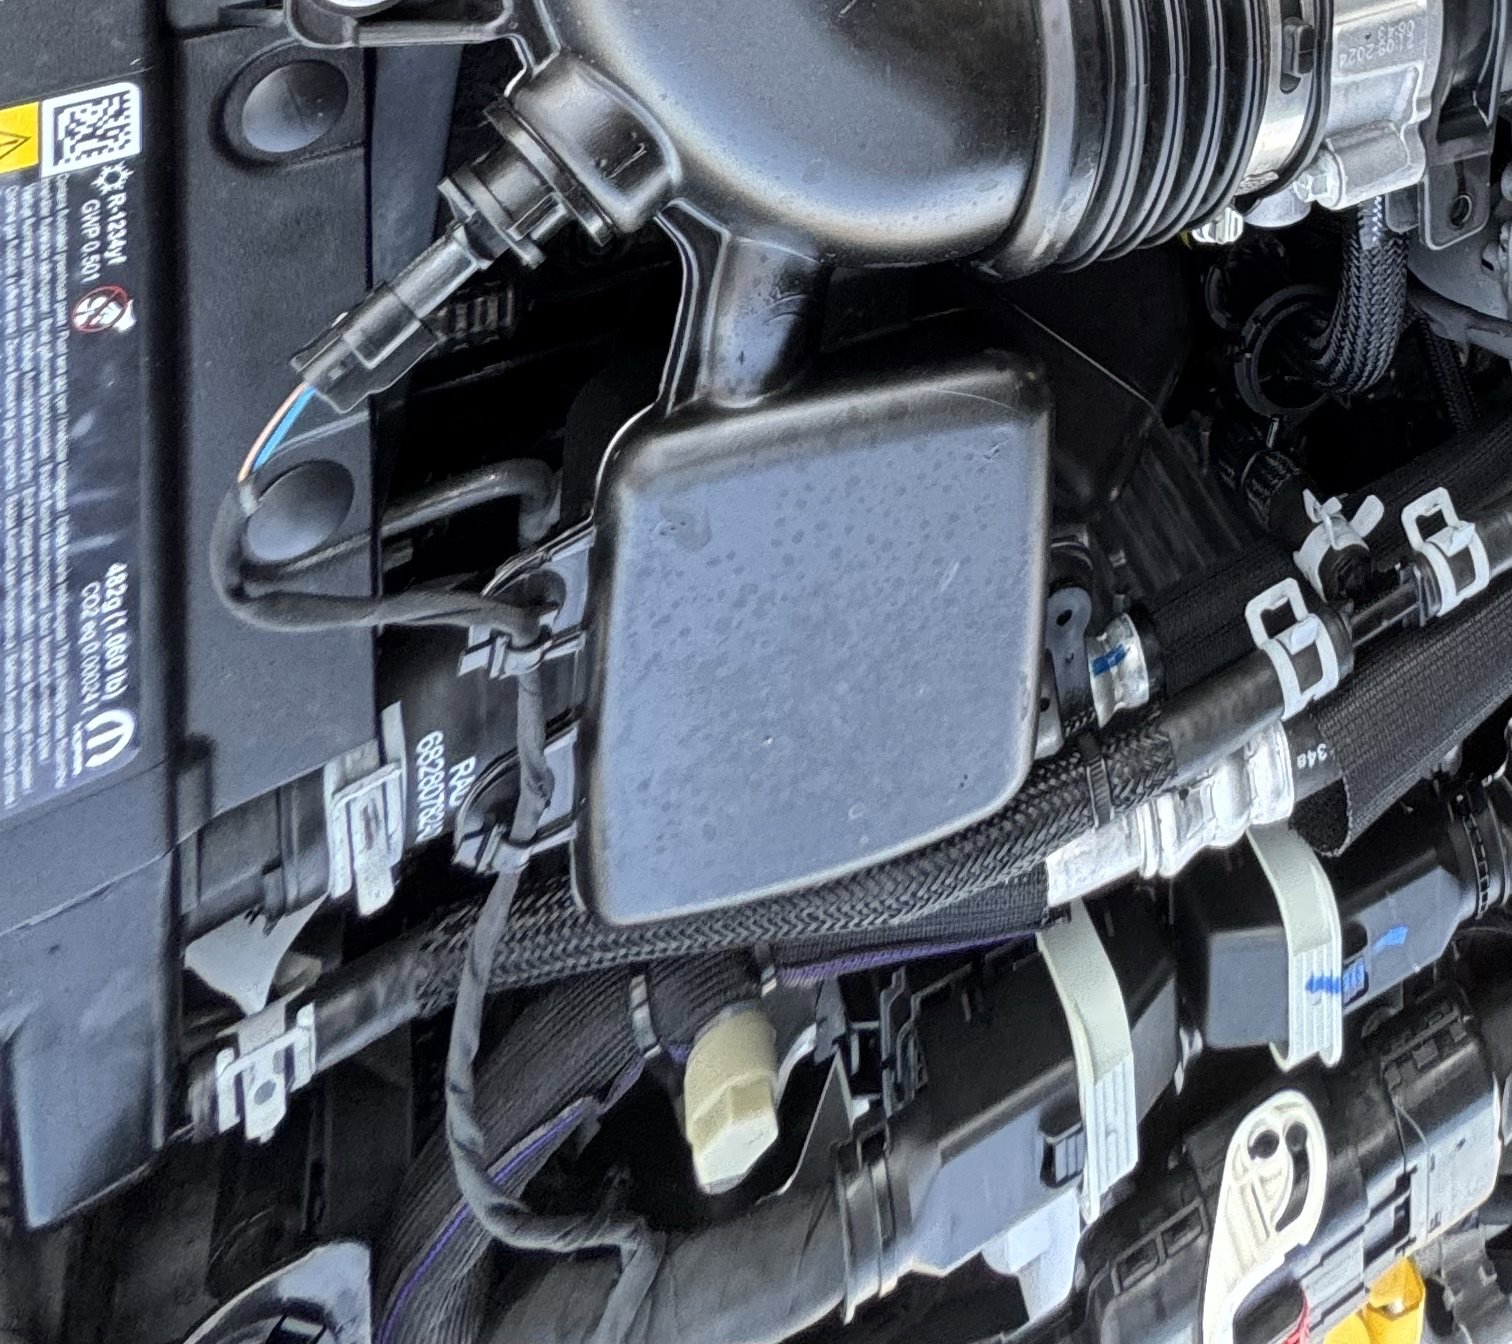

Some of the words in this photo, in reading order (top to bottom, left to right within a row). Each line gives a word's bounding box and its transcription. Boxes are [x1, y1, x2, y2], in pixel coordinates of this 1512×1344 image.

[79, 199, 102, 239] GWP
[79, 240, 102, 284] 0.501
[79, 581, 102, 622] CO2
